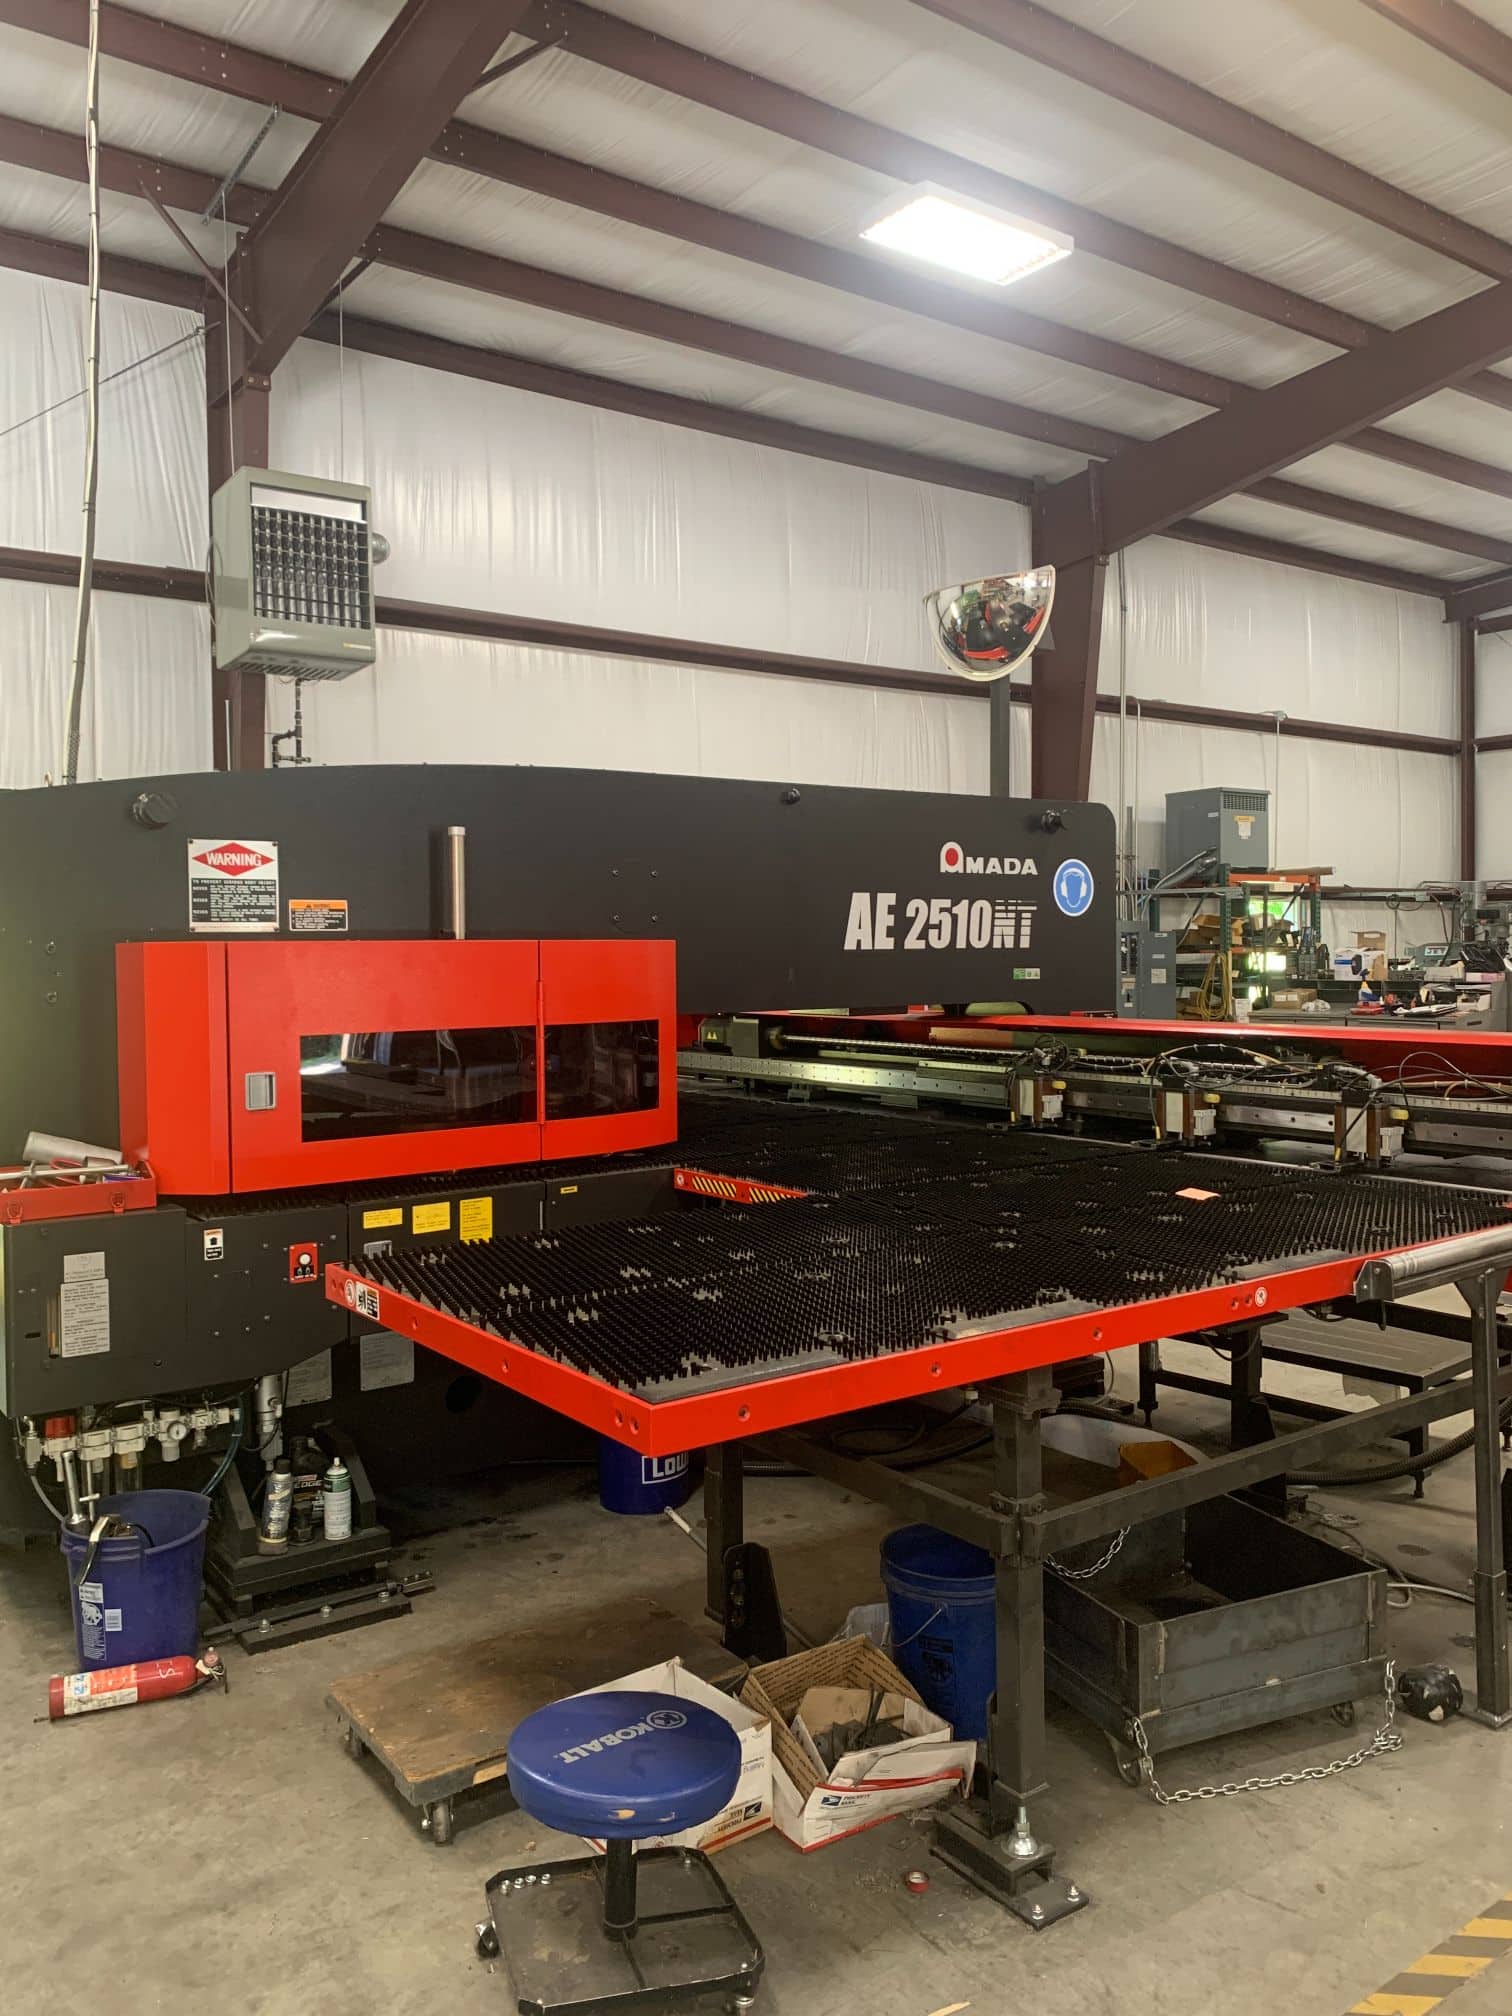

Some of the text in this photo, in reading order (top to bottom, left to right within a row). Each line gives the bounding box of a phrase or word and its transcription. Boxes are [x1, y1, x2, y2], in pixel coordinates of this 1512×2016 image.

[206, 852, 262, 867] WARNING
[940, 841, 1038, 875] AMADA
[844, 892, 897, 950] AE
[559, 1722, 655, 1764] KOBALT
